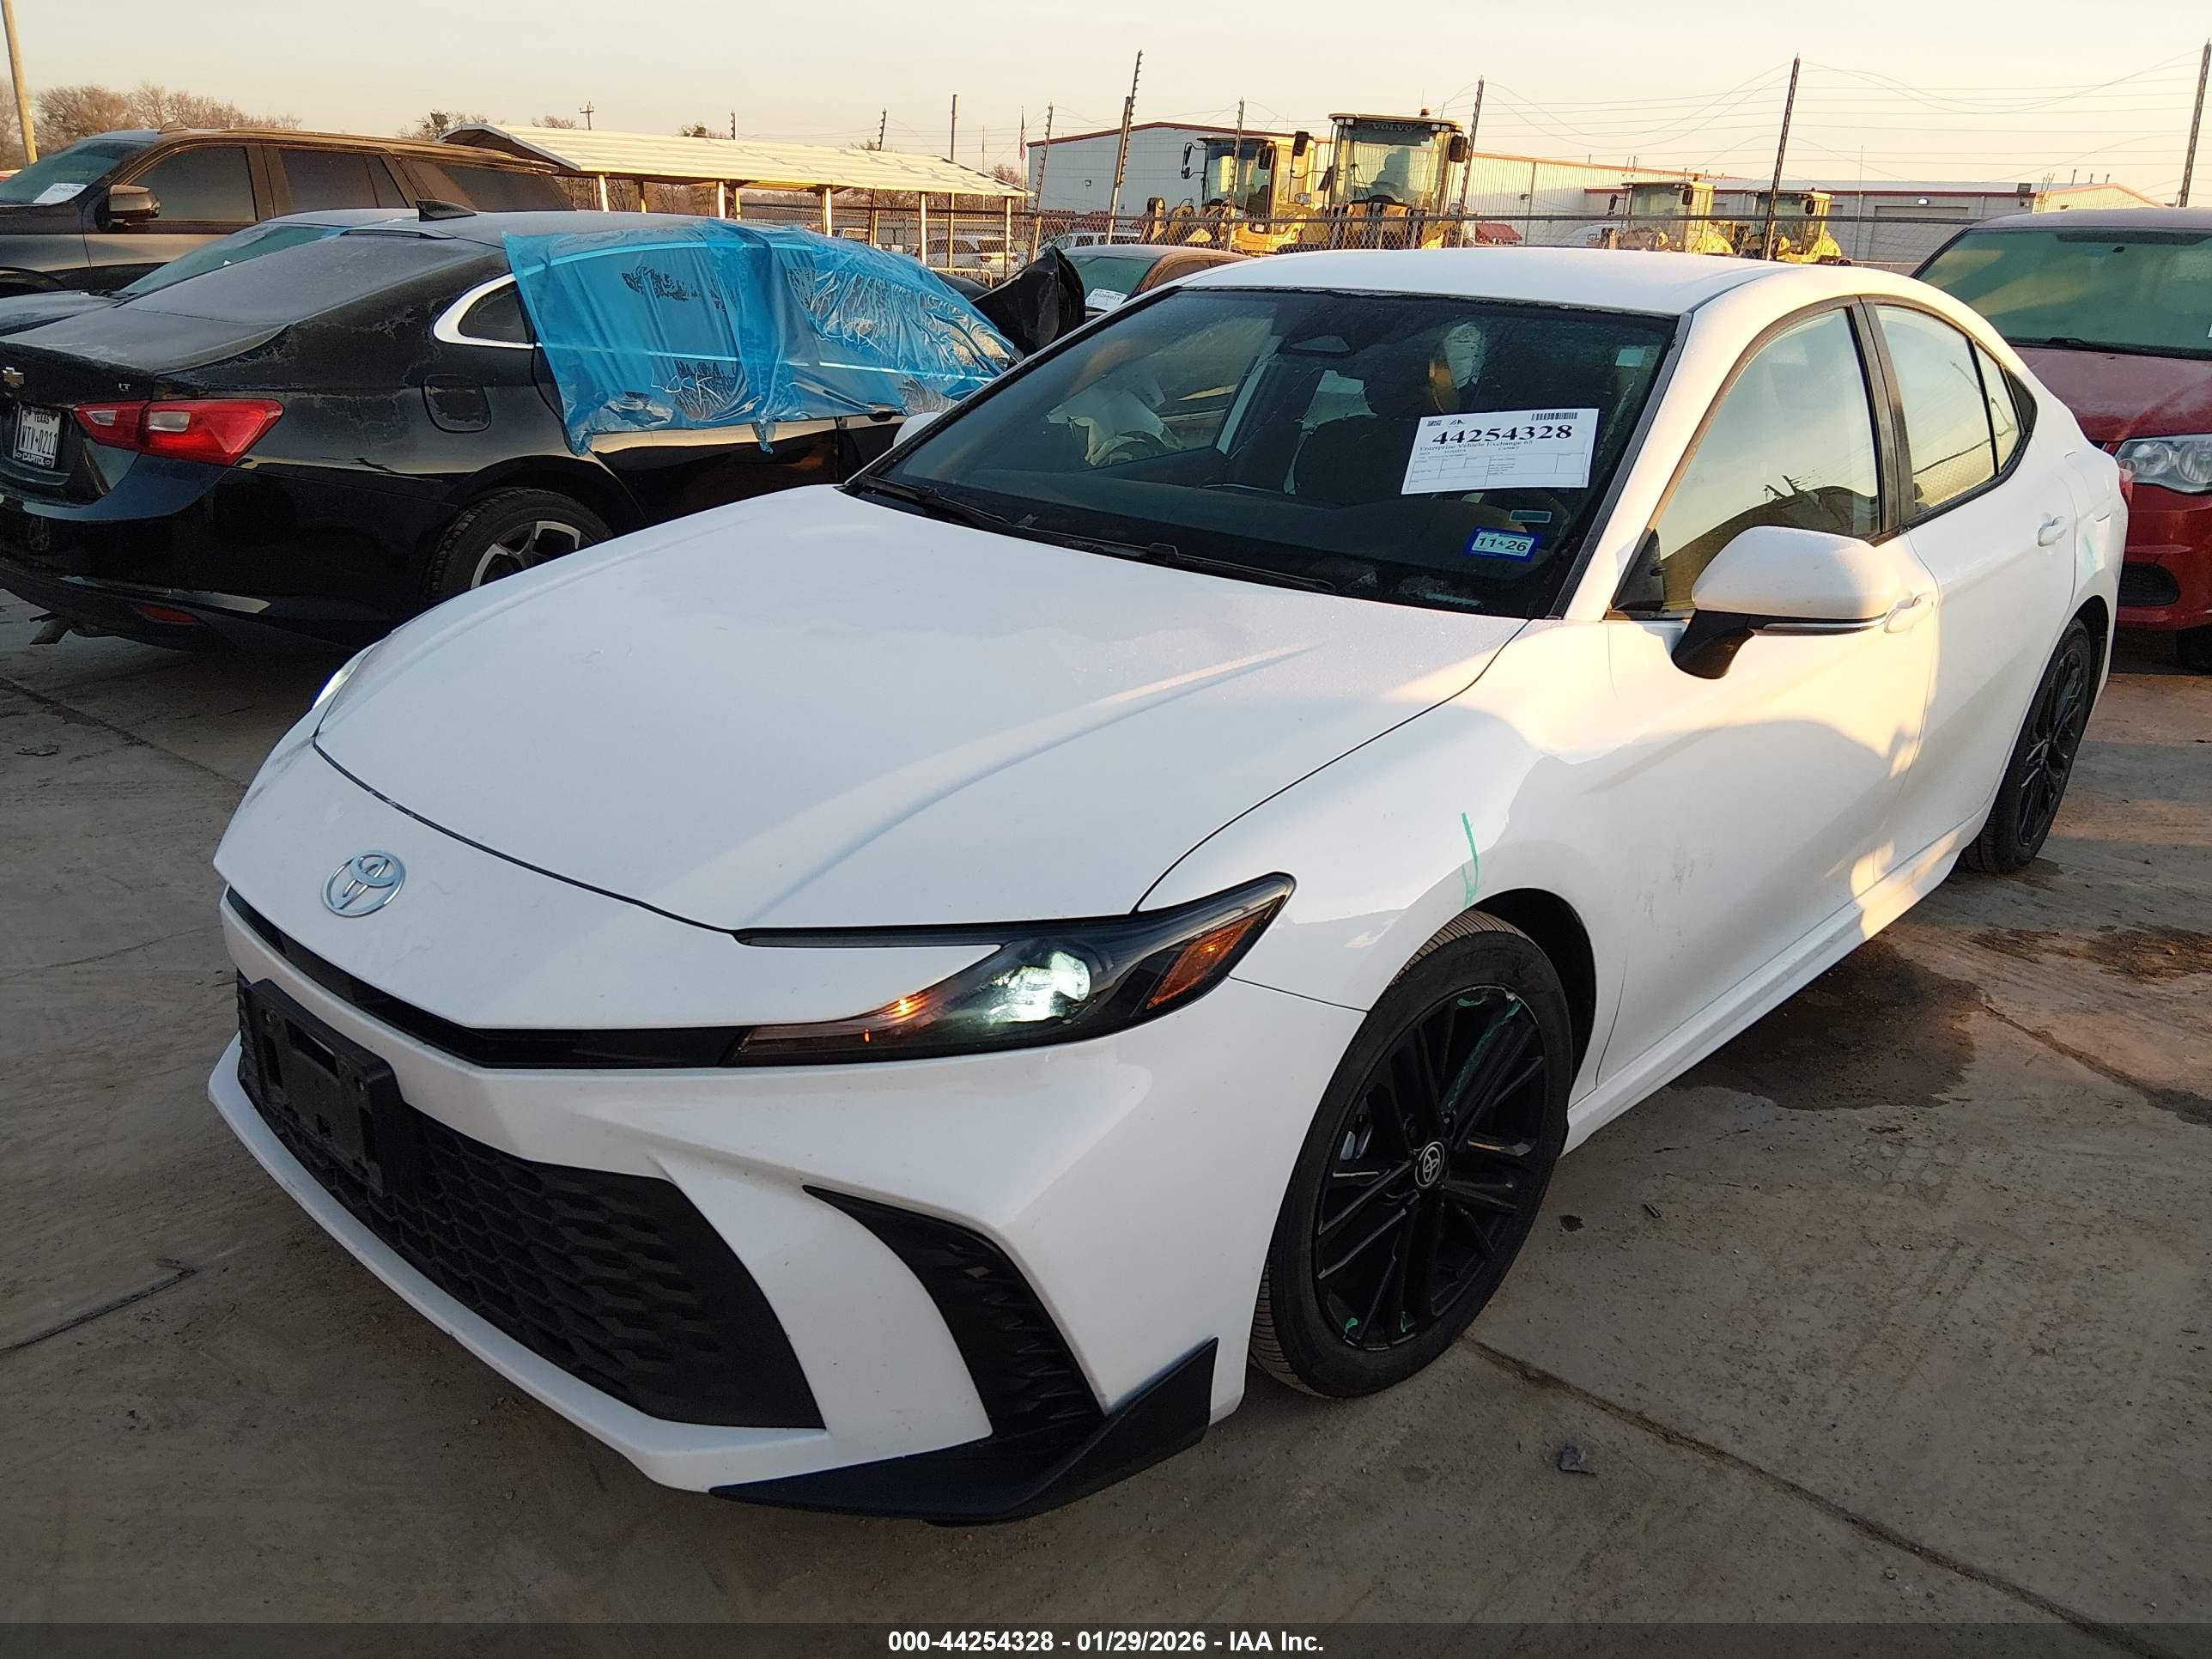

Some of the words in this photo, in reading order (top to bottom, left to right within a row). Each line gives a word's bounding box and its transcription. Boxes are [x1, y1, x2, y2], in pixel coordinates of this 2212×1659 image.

[1373, 123, 1413, 131] VOLVO
[118, 382, 131, 392] LT
[1432, 424, 1573, 445] 44254328
